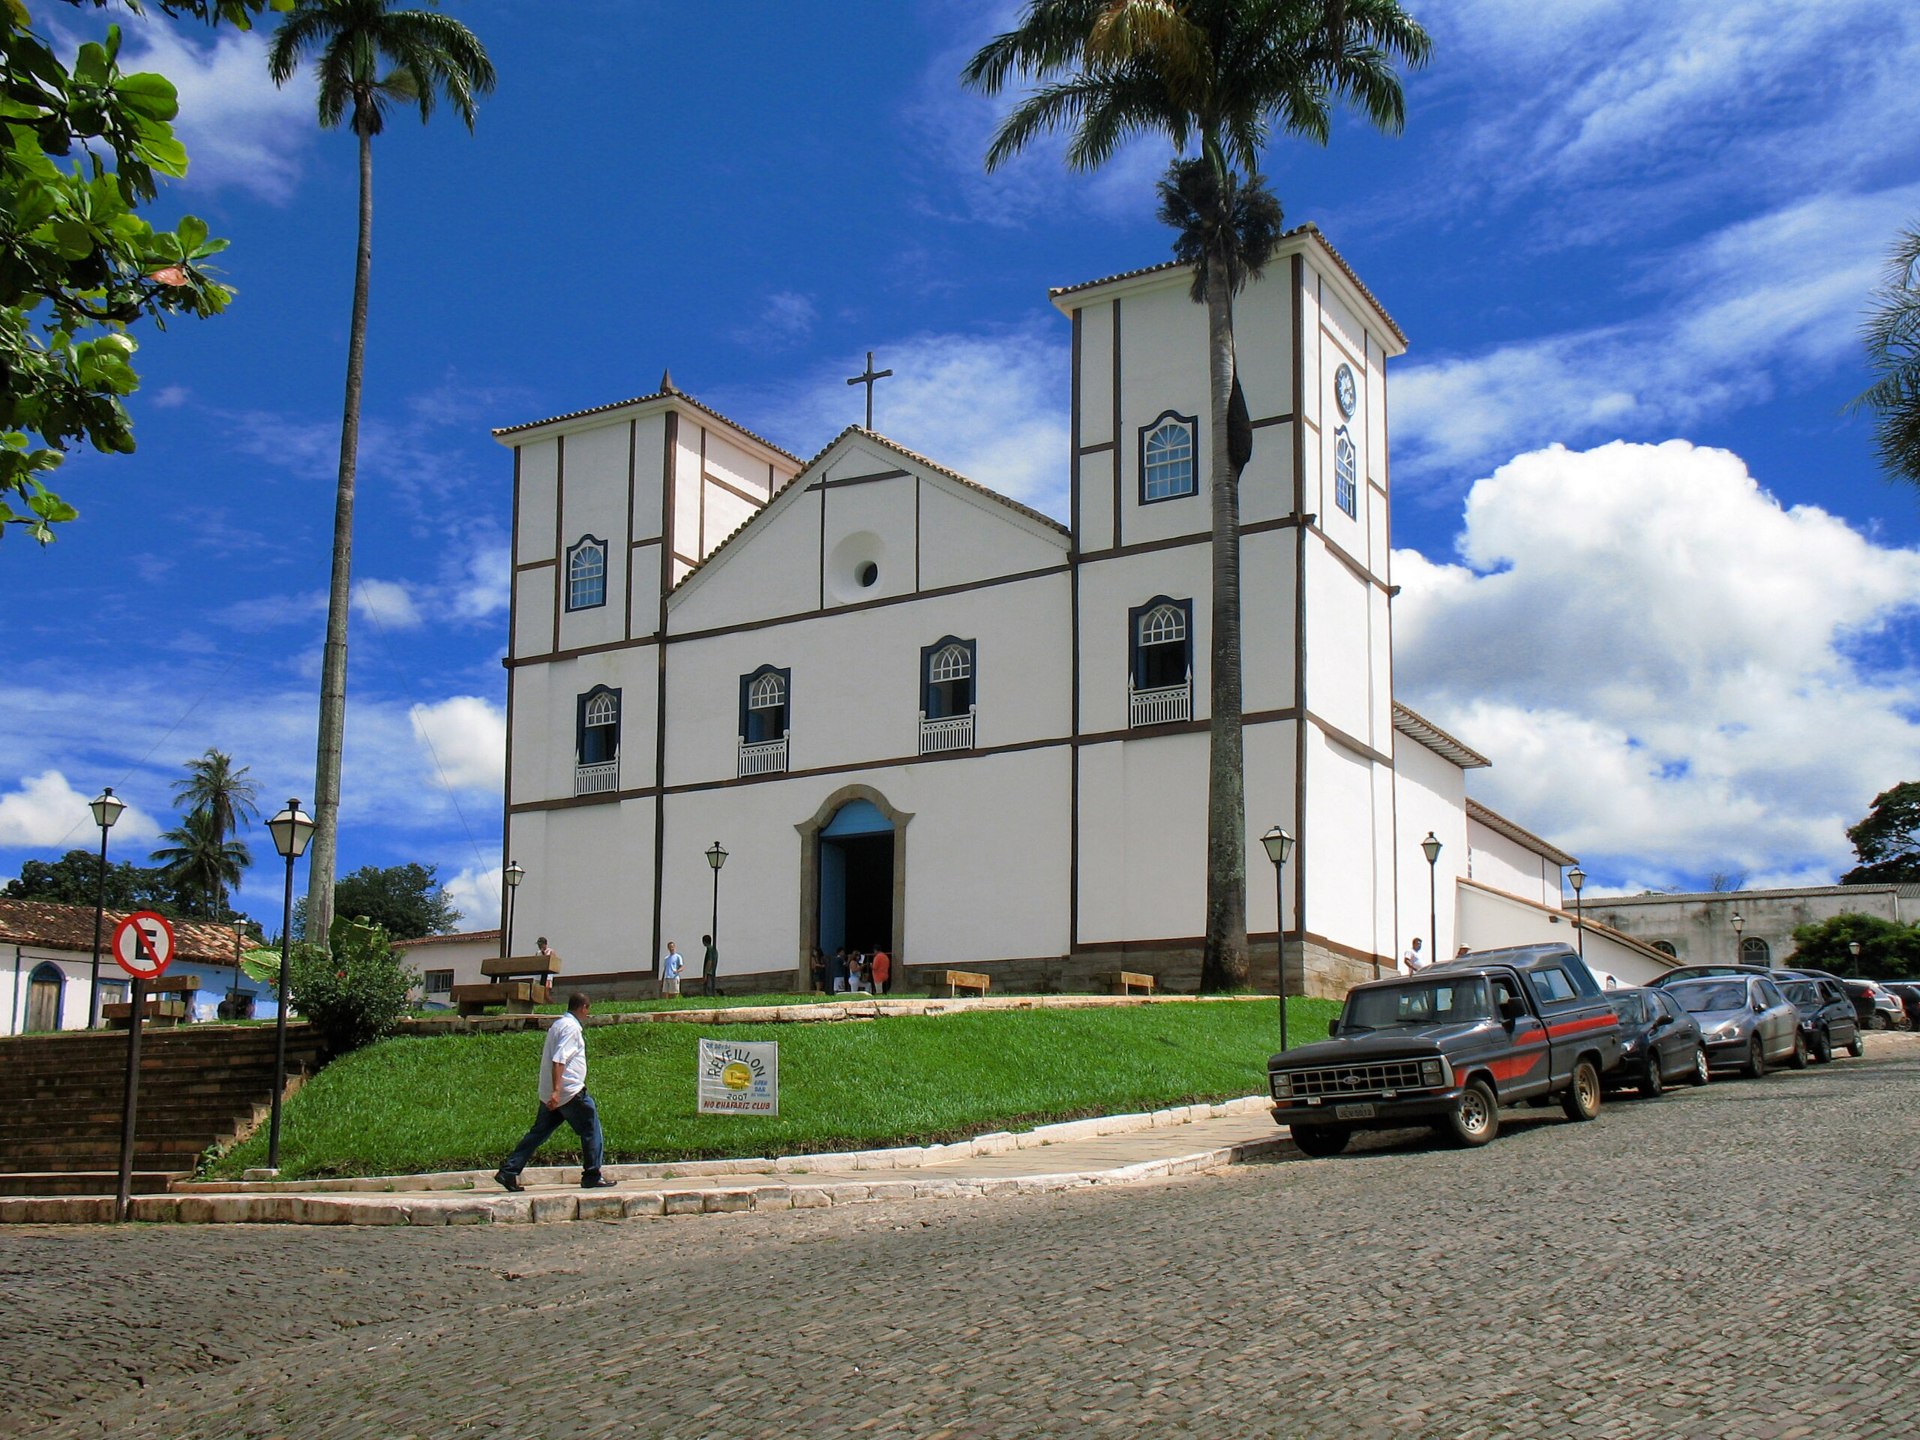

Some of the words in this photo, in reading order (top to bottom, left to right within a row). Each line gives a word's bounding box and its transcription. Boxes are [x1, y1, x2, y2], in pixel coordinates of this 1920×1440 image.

[135, 929, 157, 960] E
[707, 1049, 766, 1078] REVEILLON
[715, 1101, 750, 1109] CHAFARIZ
[726, 1093, 748, 1101] 2007
